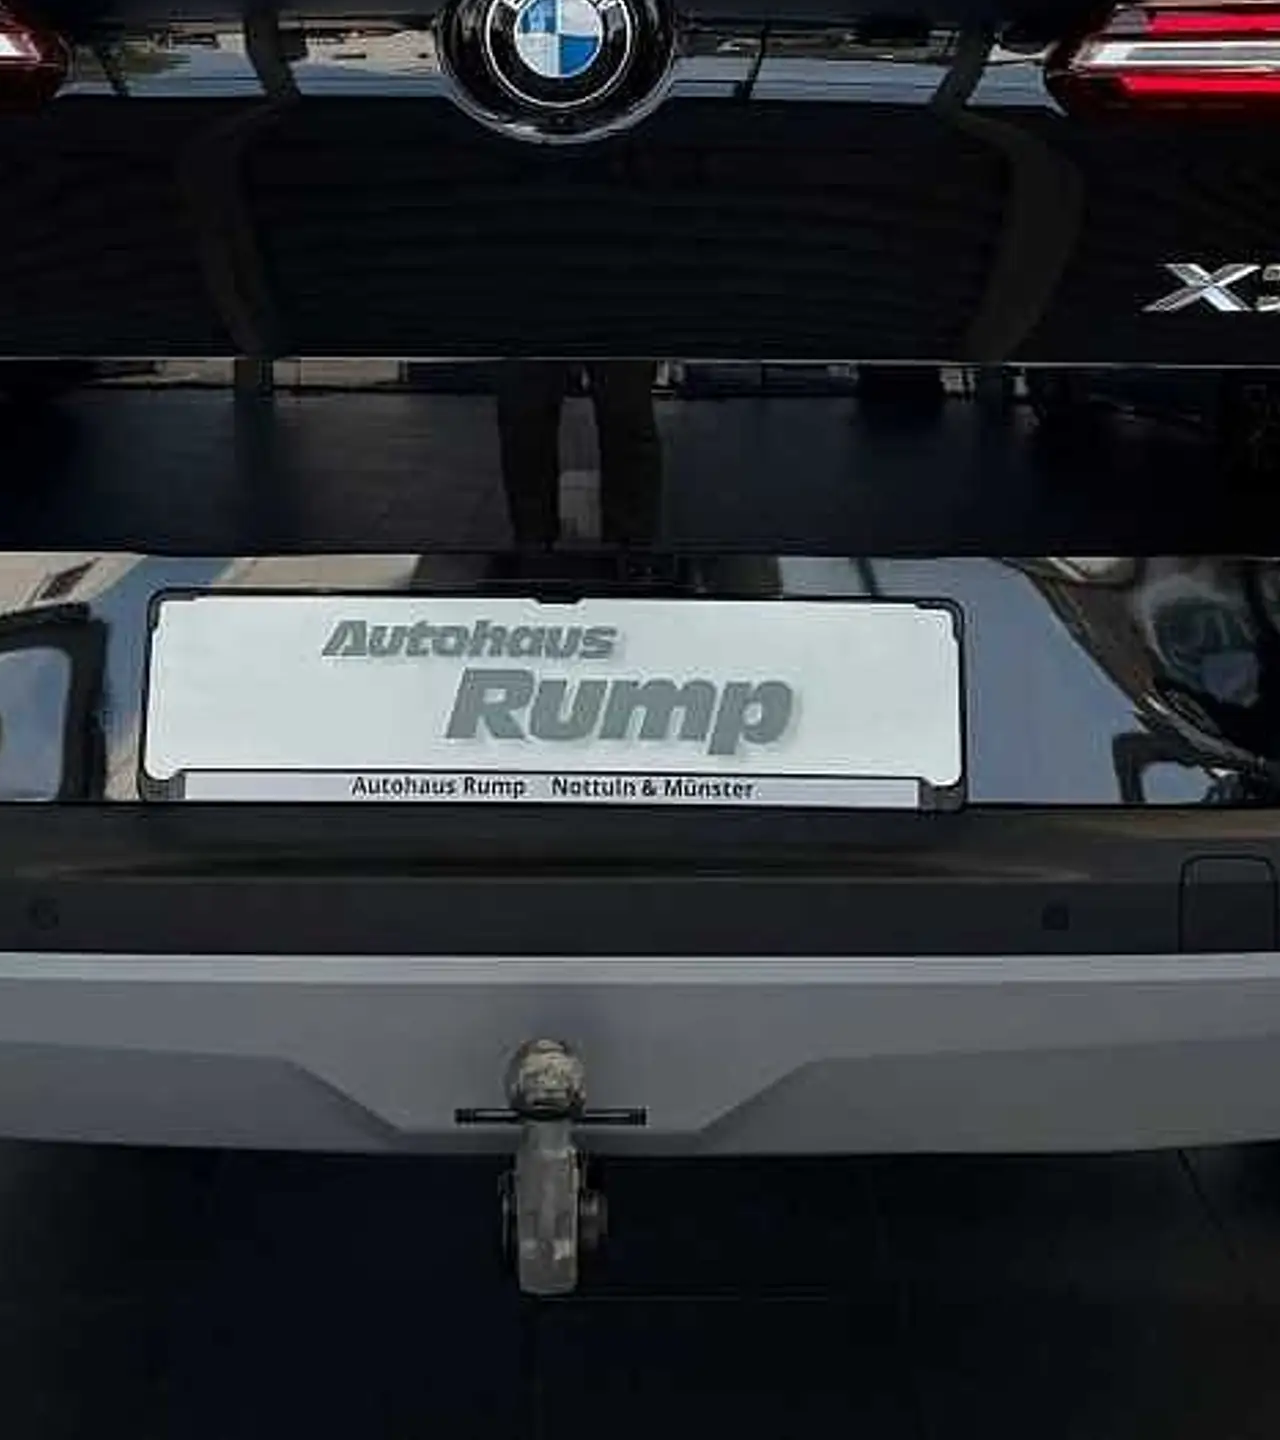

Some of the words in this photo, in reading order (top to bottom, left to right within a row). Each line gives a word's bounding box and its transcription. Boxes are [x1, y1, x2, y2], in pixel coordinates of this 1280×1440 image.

[321, 619, 618, 659] Autohaus
[445, 667, 794, 755] Rump
[352, 775, 456, 796] Autohaus
[463, 776, 527, 799] Rump
[551, 776, 637, 797] Nottuln
[641, 778, 656, 797] &
[665, 777, 754, 799] Münster
